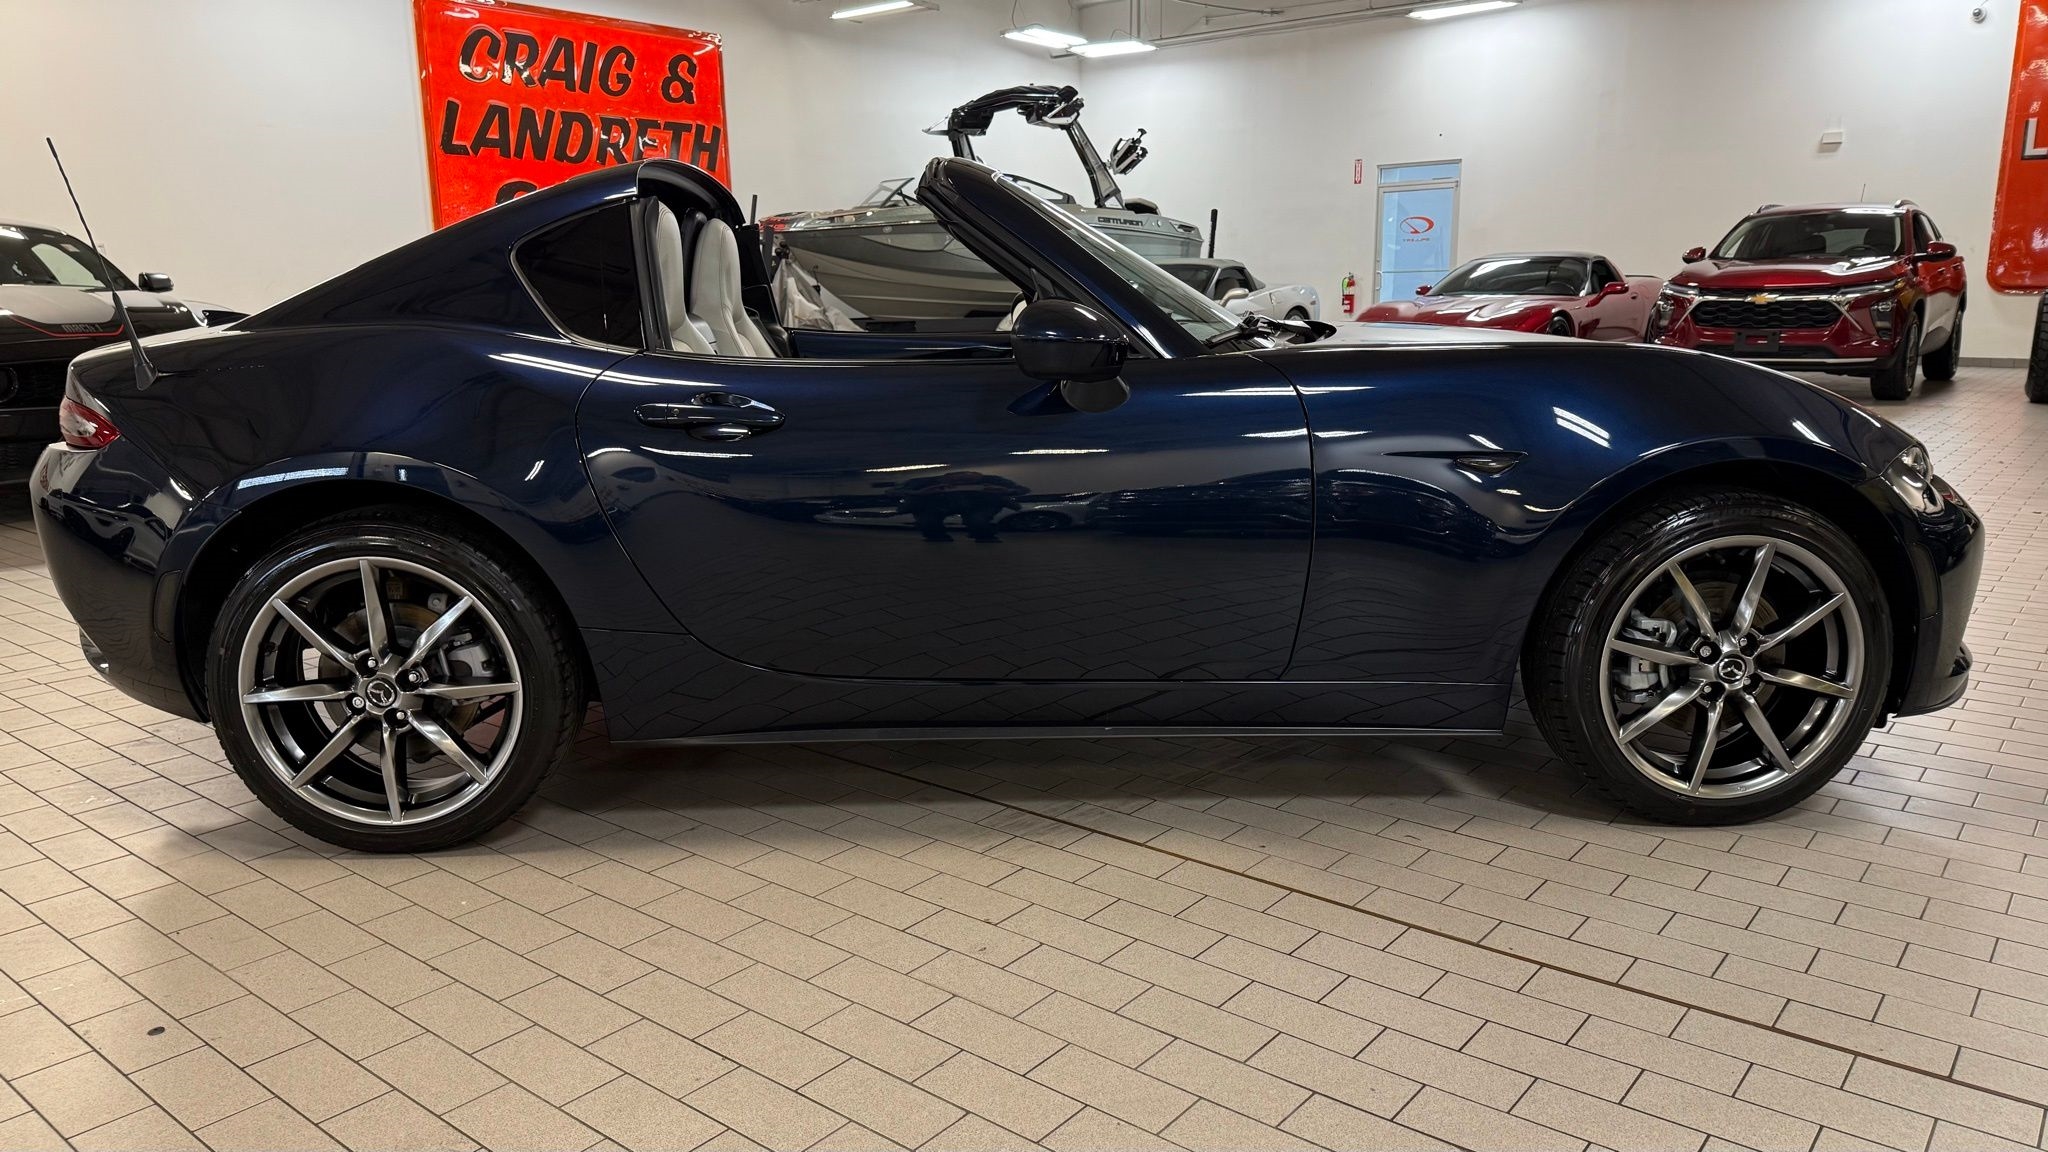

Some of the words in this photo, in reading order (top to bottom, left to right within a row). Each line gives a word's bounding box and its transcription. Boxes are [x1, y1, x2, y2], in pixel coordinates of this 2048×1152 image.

[459, 28, 635, 97] CRAIG
[661, 55, 697, 104] &
[440, 99, 722, 173] LANDRETH
[1097, 216, 1144, 227] CENTURION
